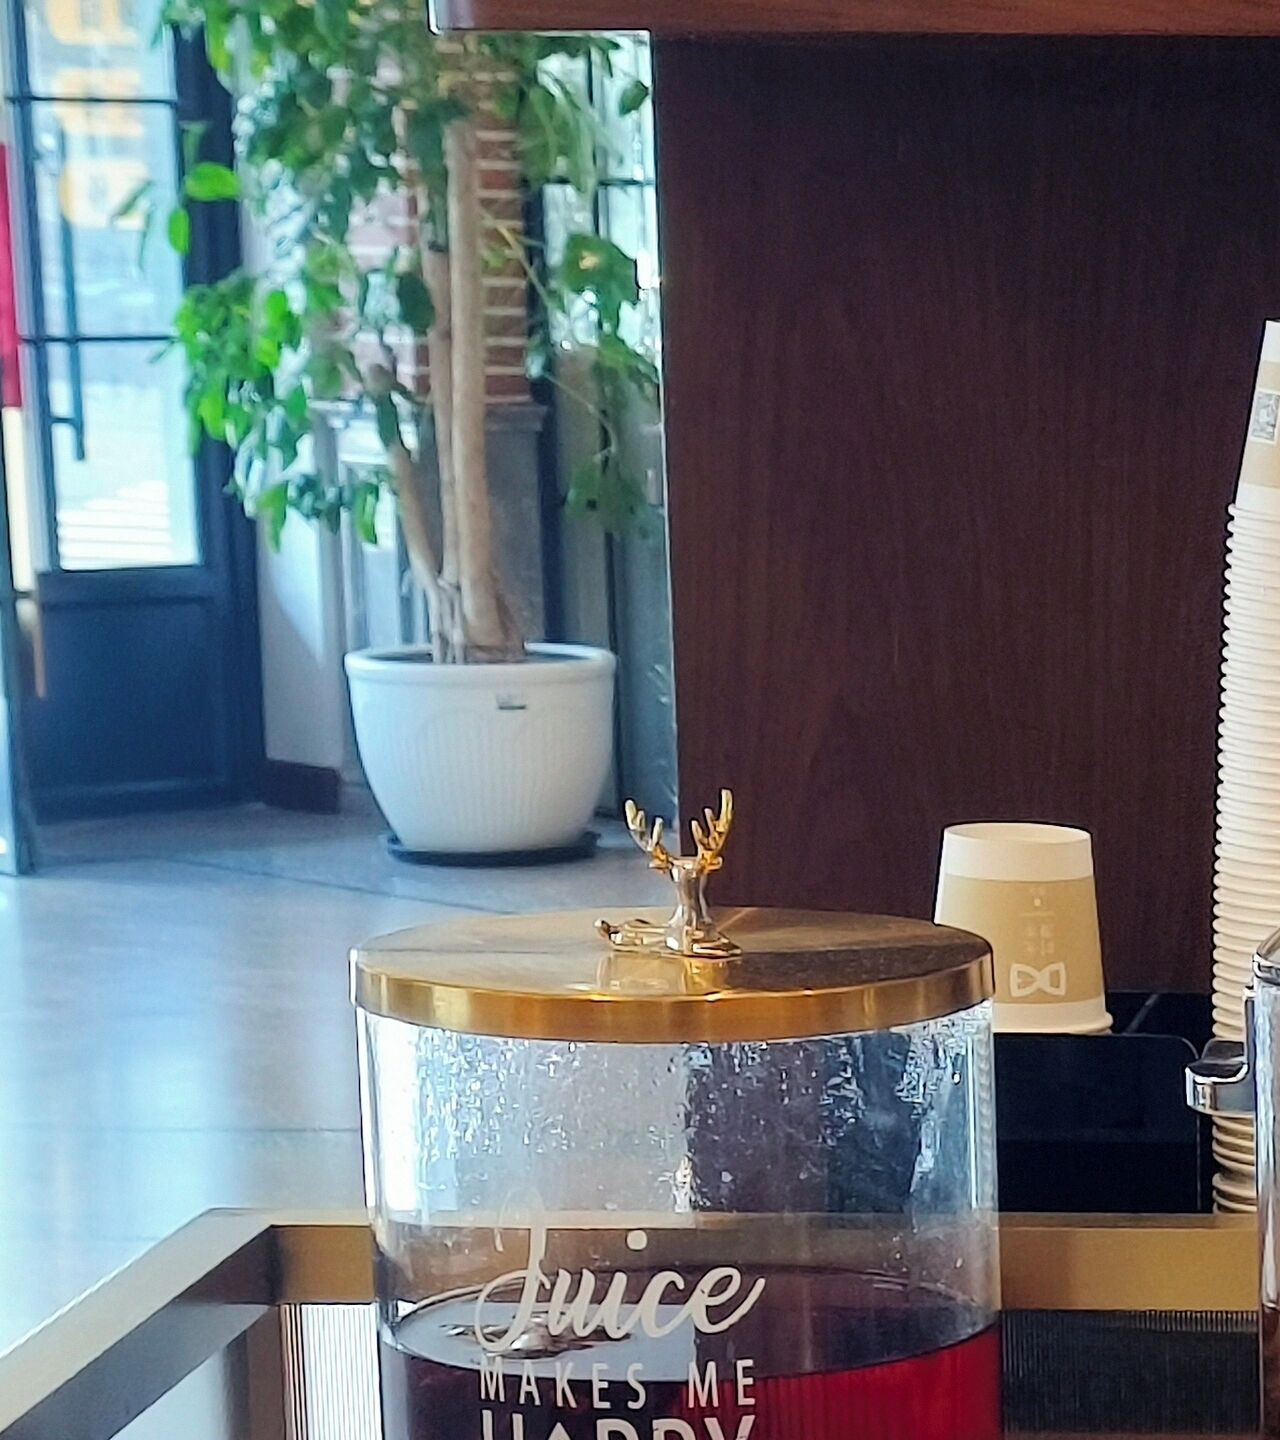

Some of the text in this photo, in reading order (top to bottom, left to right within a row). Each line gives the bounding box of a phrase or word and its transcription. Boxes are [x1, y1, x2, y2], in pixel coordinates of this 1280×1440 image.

[474, 1188, 766, 1352] Juice
[479, 1358, 757, 1410] MAKES ME
